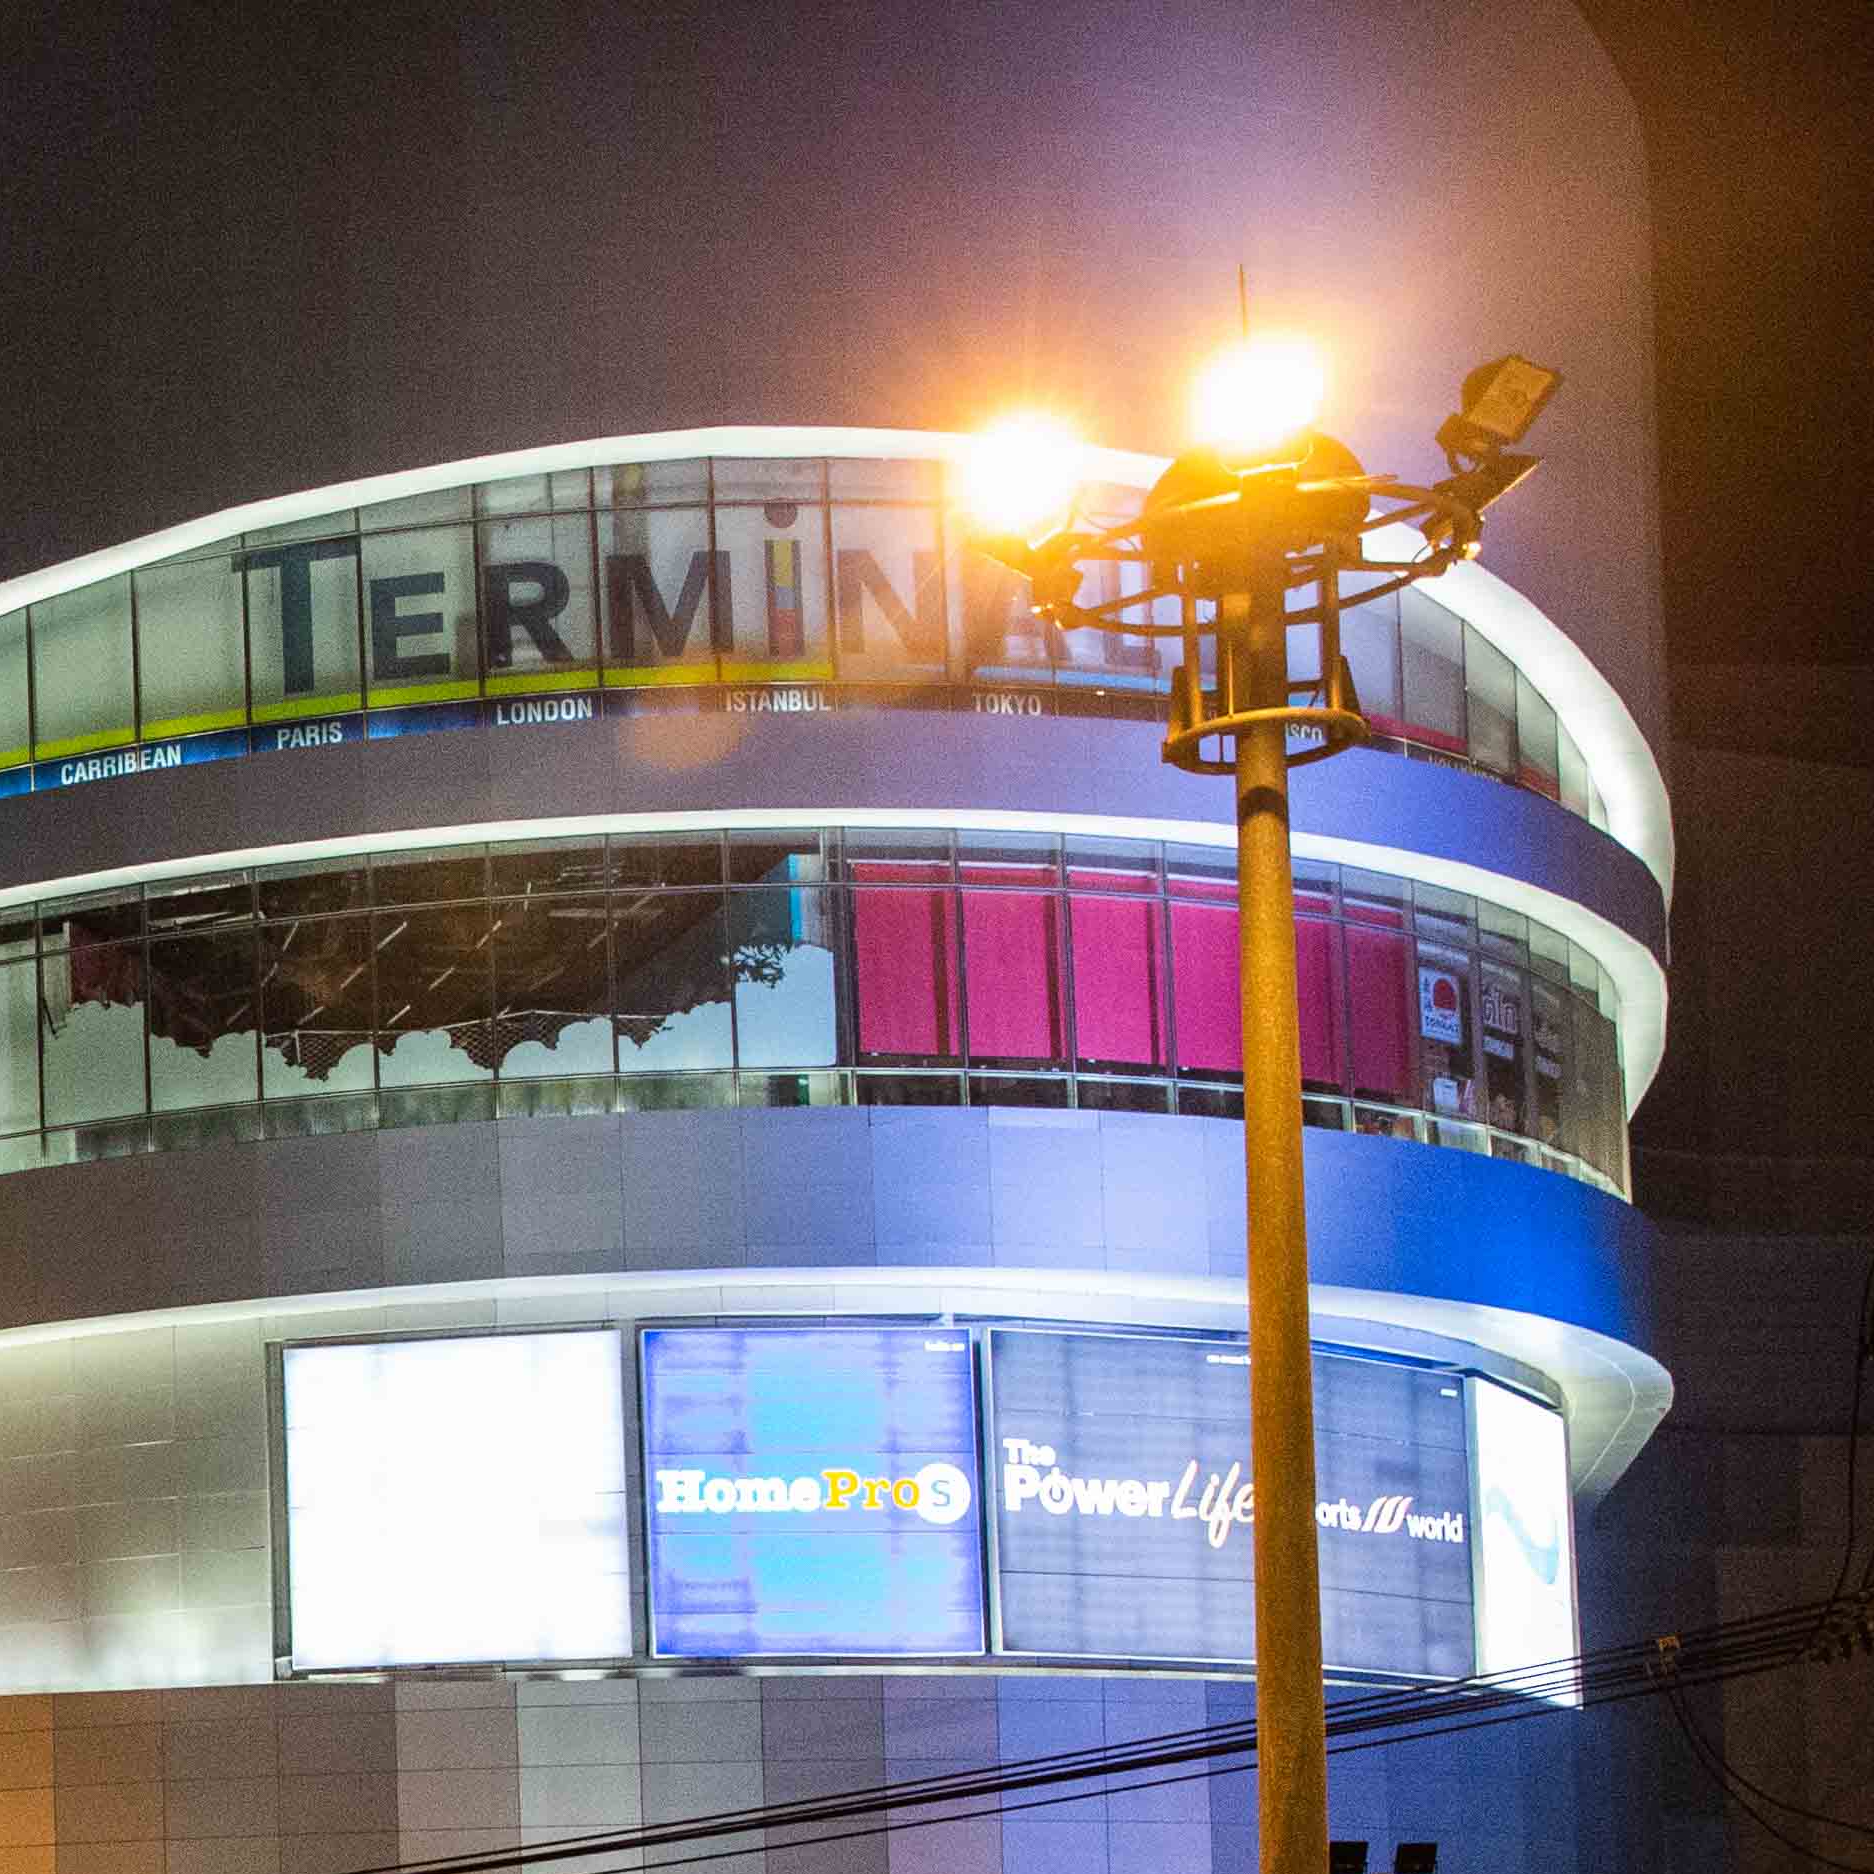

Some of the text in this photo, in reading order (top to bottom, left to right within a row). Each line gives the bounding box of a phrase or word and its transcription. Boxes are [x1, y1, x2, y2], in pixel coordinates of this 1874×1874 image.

[496, 696, 593, 726] LONDON
[725, 689, 833, 715] ISTANBUL
[972, 692, 1042, 717] TOKYO
[277, 721, 344, 750] PARIS
[60, 744, 183, 786] CARRIBEAN
[1002, 1437, 1057, 1467] The
[1405, 1512, 1464, 1543] world
